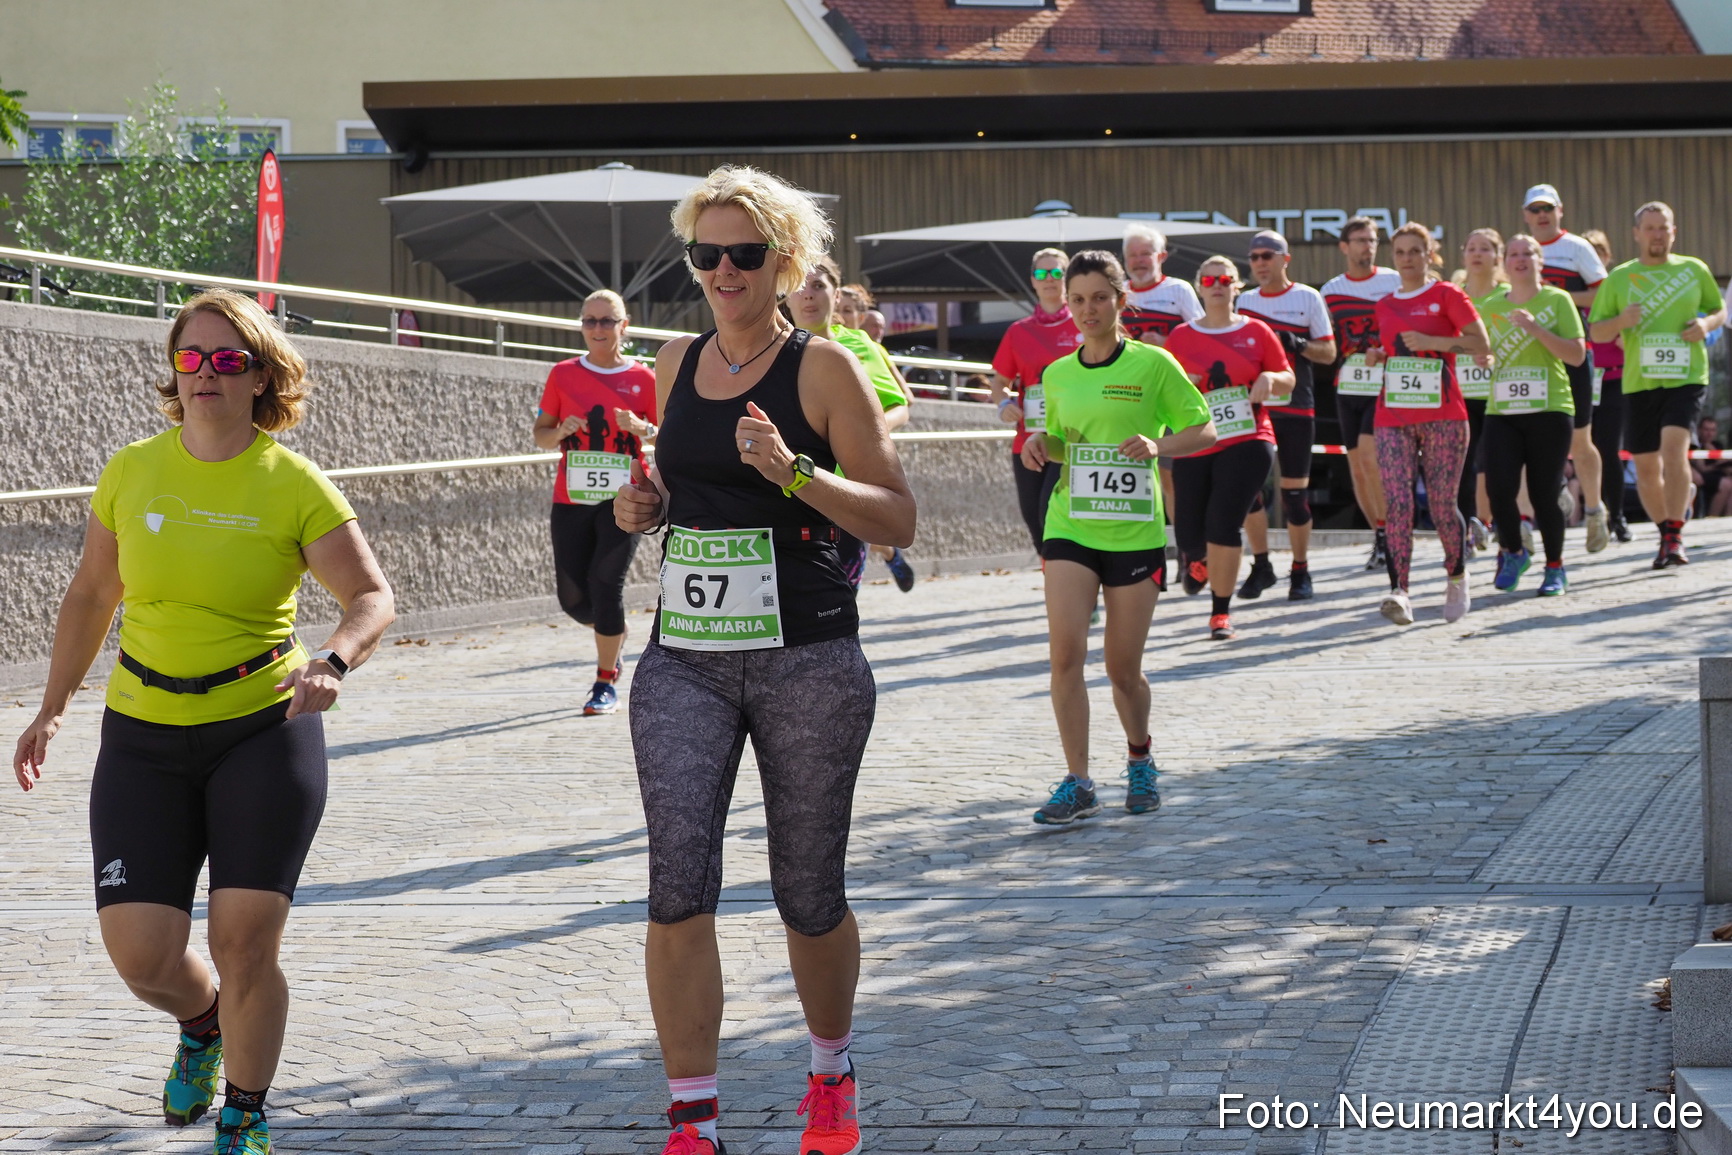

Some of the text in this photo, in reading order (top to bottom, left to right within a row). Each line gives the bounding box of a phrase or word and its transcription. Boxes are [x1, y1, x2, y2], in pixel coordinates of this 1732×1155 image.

[1655, 349, 1675, 362] 99
[1391, 360, 1437, 372] BOCK
[1354, 369, 1371, 381] 81
[1463, 368, 1493, 381] 100
[1401, 375, 1422, 390] 54
[1207, 389, 1241, 403] OCK
[1508, 383, 1530, 397] 98
[1212, 404, 1236, 423] 56
[572, 453, 626, 468] BOCK
[586, 472, 609, 487] 55
[1088, 471, 1136, 494] 149
[584, 492, 614, 500] TANJA
[1090, 500, 1132, 511] TANJA
[192, 509, 216, 517] Kliniken
[208, 517, 237, 525] Neumarkt
[669, 533, 763, 562] BOCK
[684, 573, 729, 609] 67
[817, 607, 842, 618] benger
[668, 616, 767, 633] ANNA-MARIA
